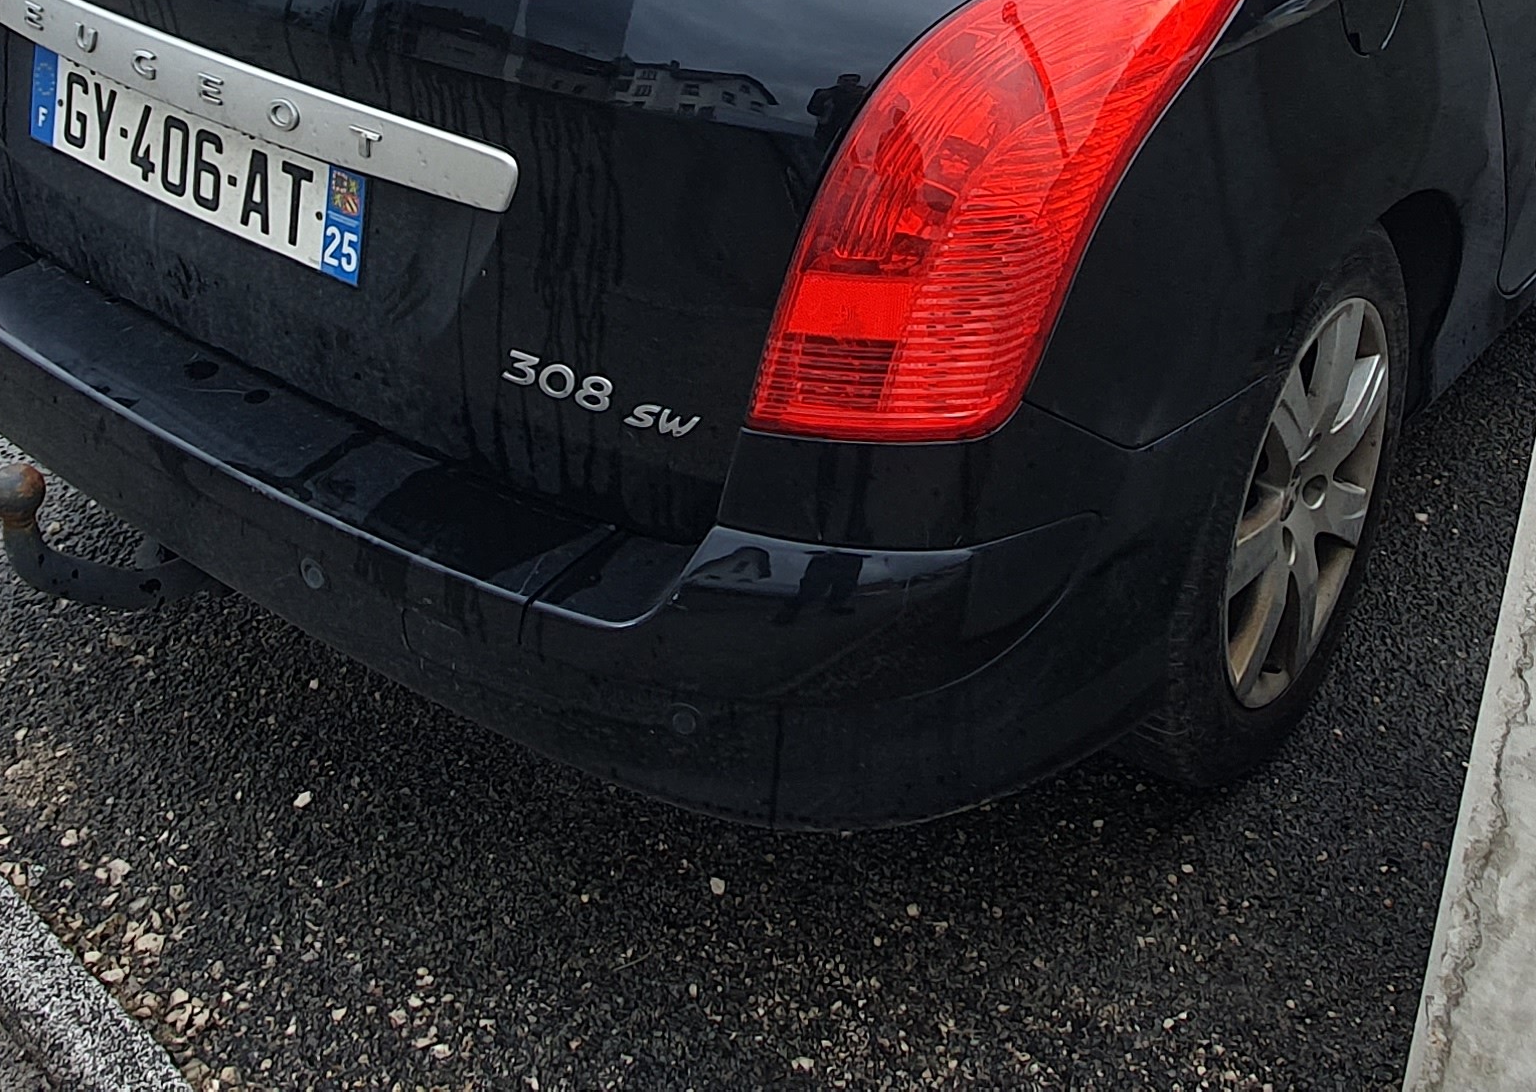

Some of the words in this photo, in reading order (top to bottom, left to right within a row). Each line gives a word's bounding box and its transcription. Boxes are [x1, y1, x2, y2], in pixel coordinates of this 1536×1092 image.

[37, 105, 49, 129] F
[64, 71, 314, 247] GY-406-AT
[323, 225, 359, 273] 25
[501, 348, 614, 413] 308
[623, 403, 702, 438] SW
